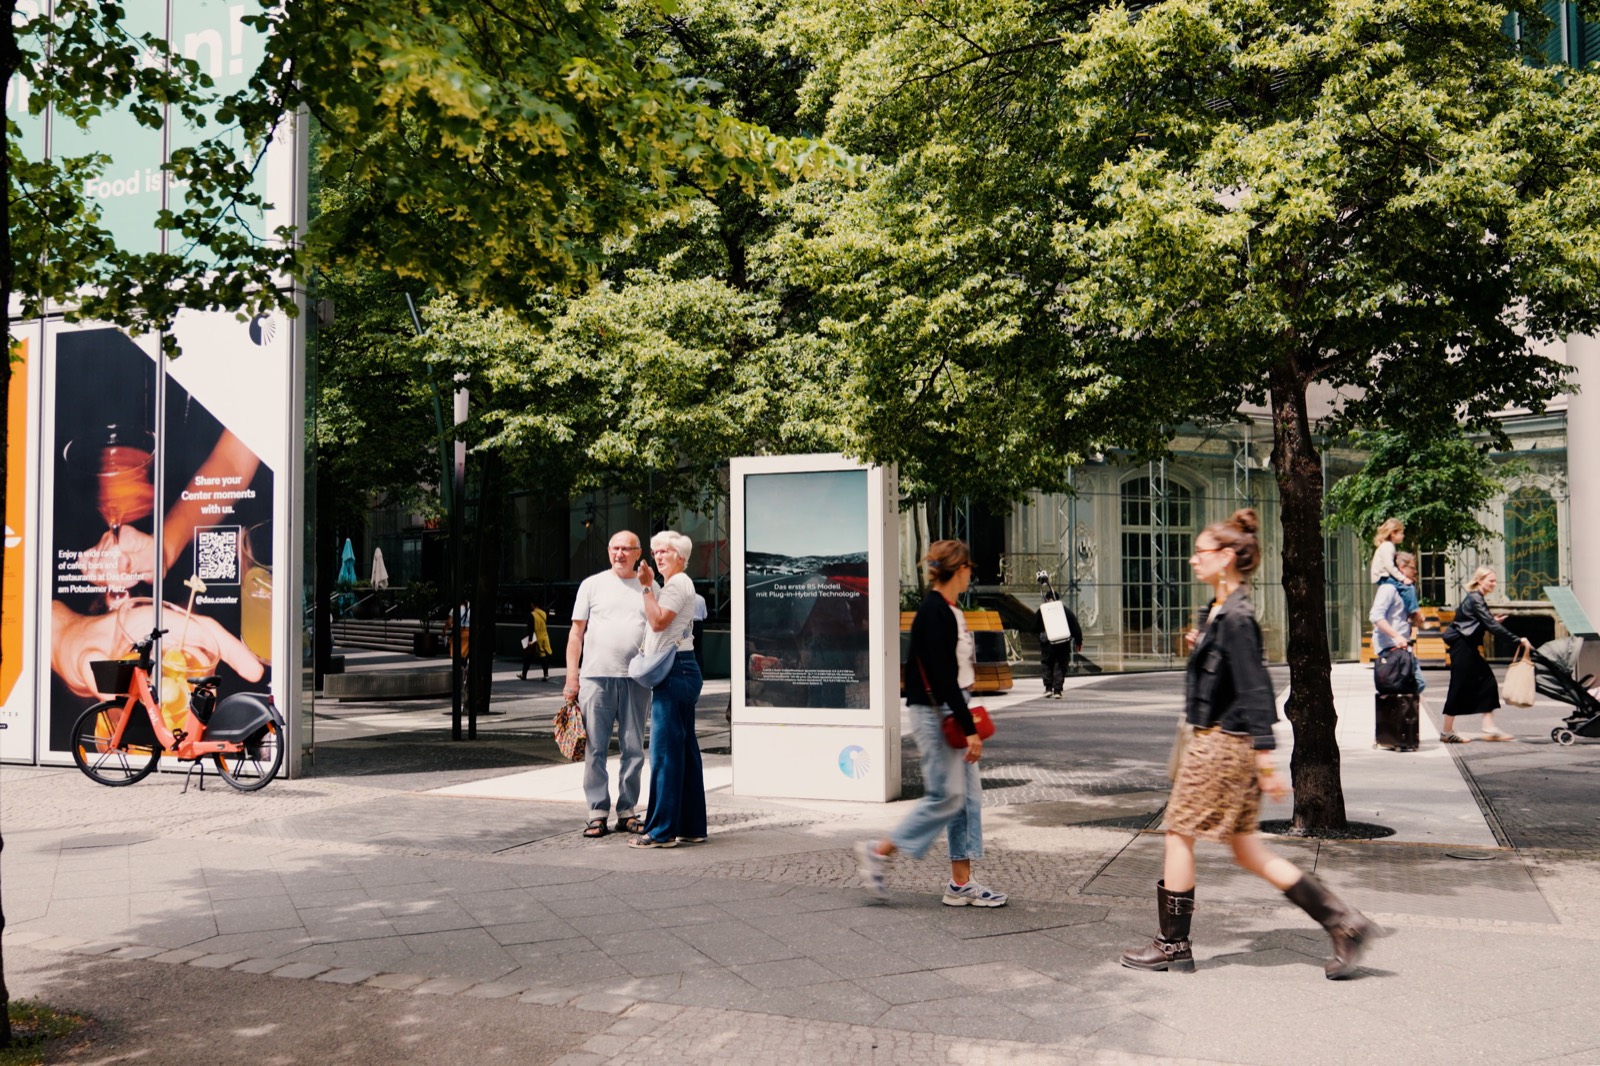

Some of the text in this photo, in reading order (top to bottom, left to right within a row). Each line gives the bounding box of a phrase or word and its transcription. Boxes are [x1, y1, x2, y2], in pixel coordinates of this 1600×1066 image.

[86, 169, 140, 199] Food
[145, 168, 161, 193] is
[195, 476, 242, 487] Share your
[181, 489, 256, 501] Center moments
[201, 504, 235, 514] with us.
[58, 549, 77, 560] Enjoy
[101, 550, 121, 559] range
[58, 561, 66, 569] of
[107, 573, 119, 581] Das
[120, 572, 144, 581] Center
[70, 585, 107, 593] Potsdamer
[769, 591, 818, 599] Plug-in-Hybrid
[819, 590, 860, 598] Technologie
[195, 595, 238, 605] @das.center
